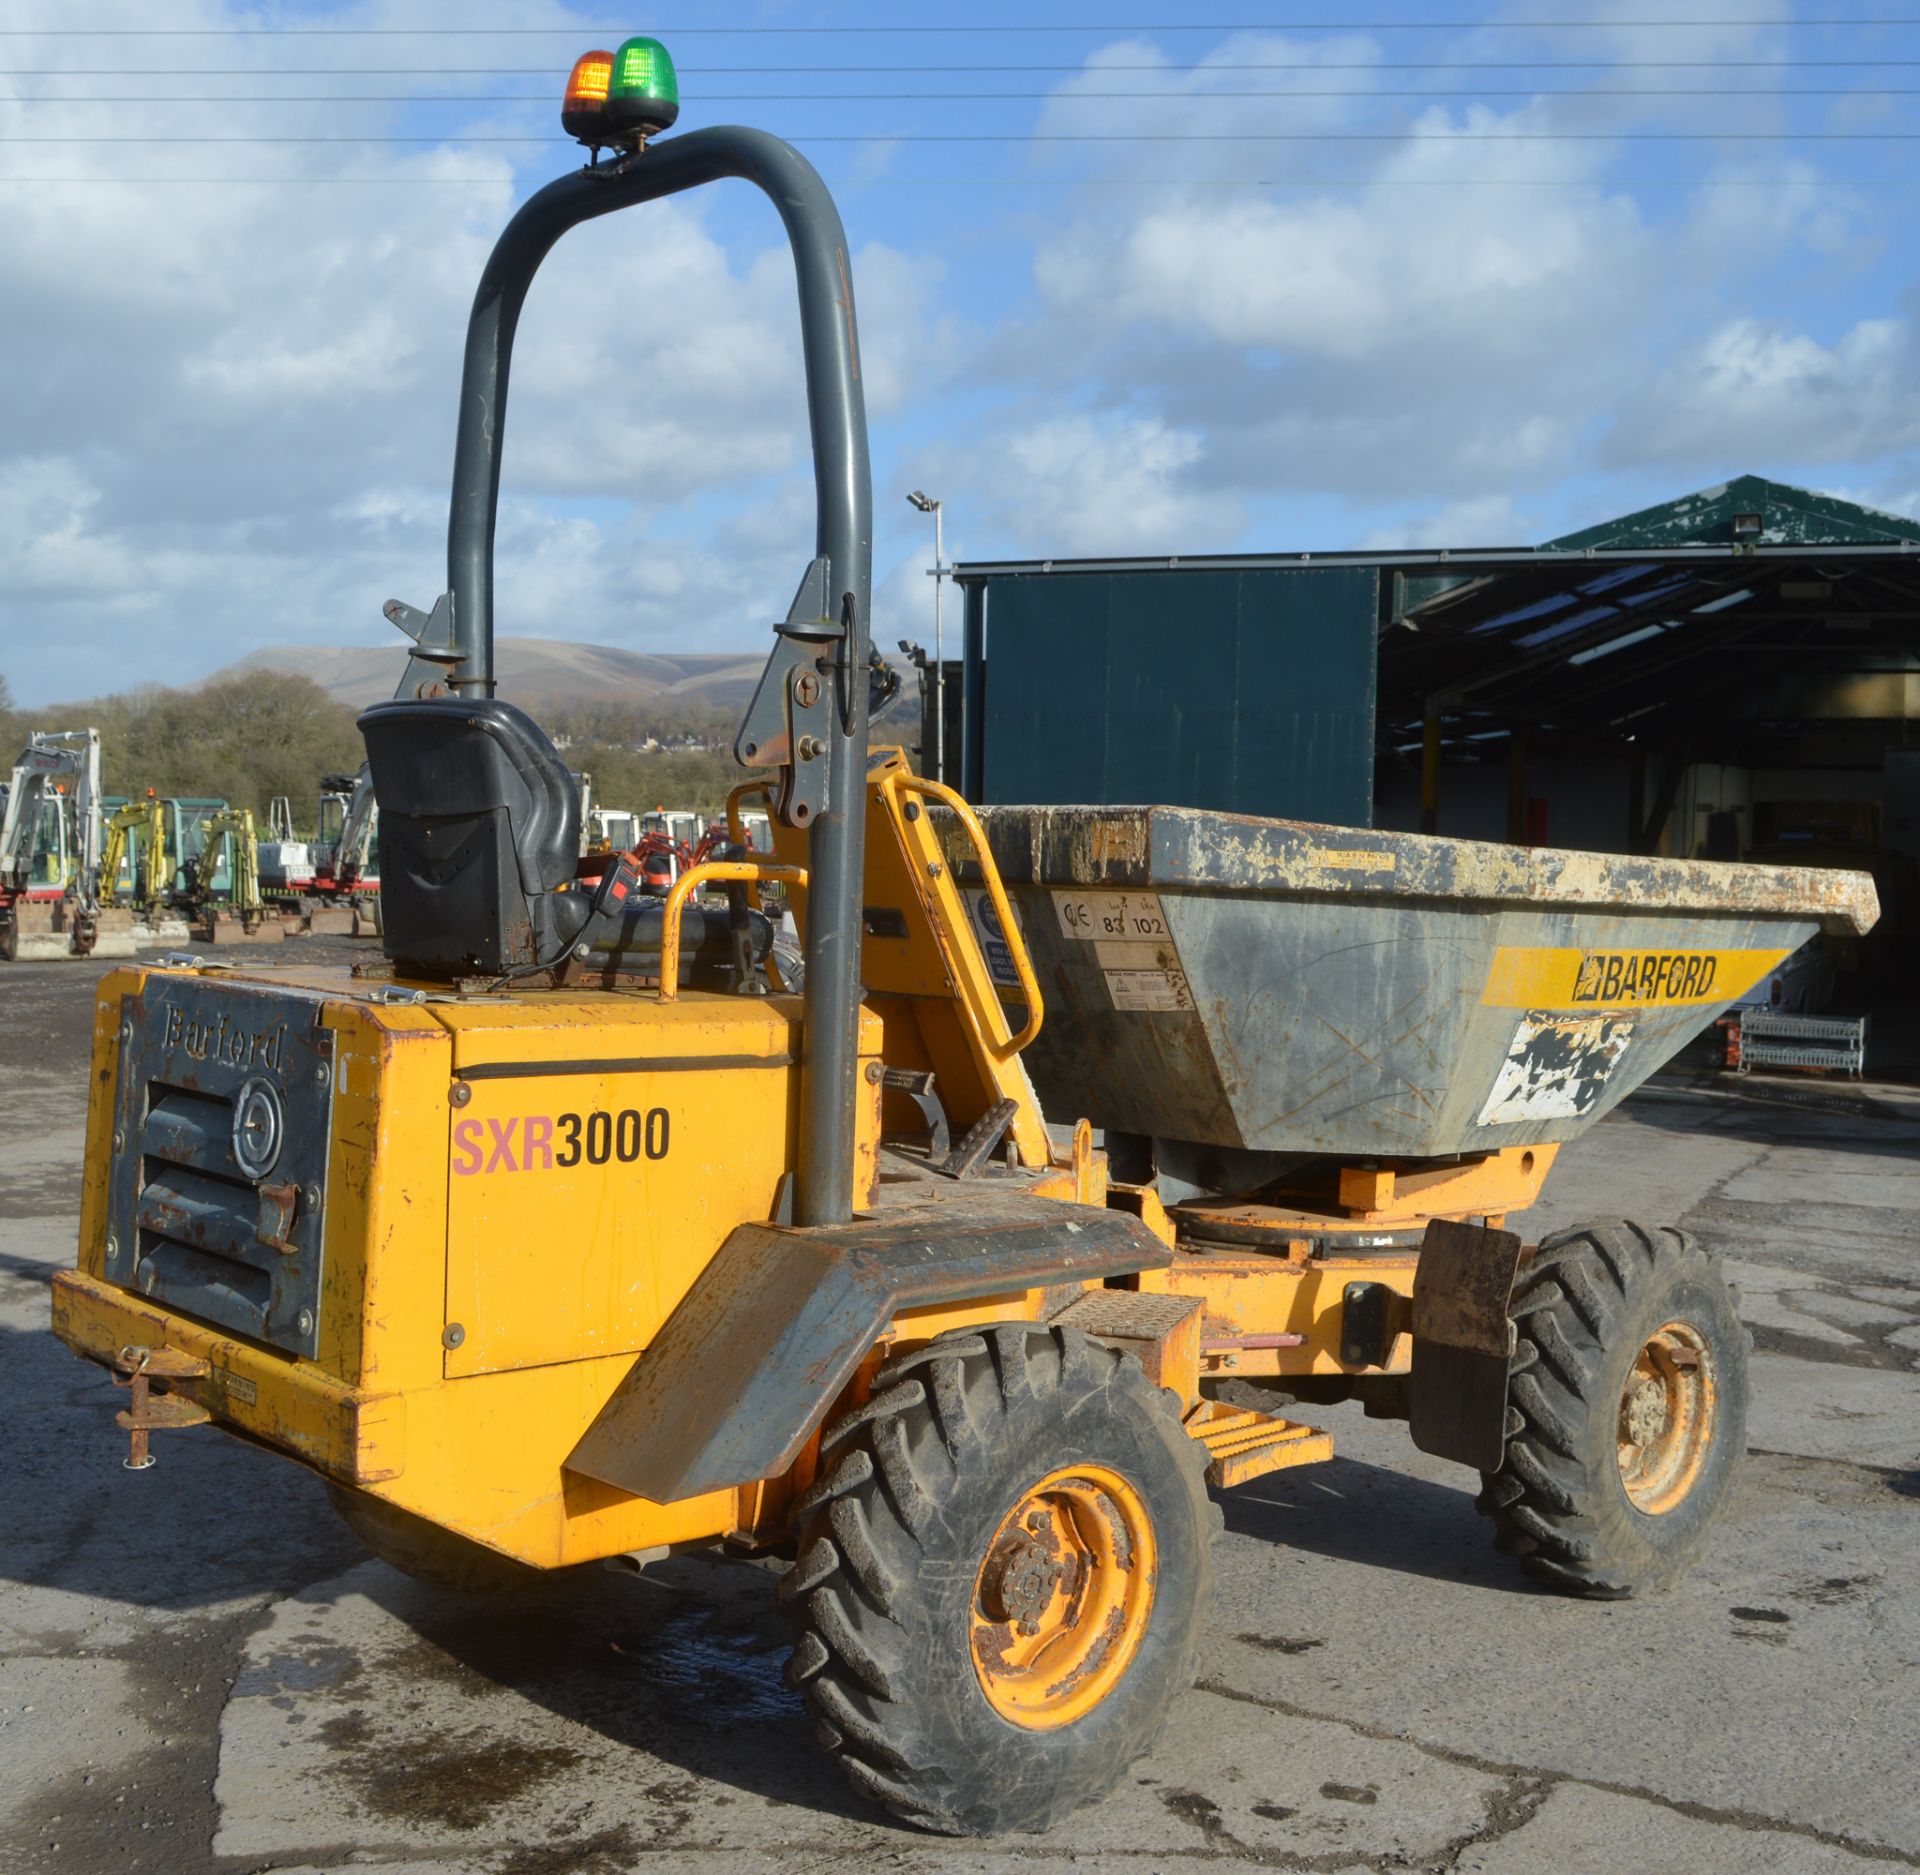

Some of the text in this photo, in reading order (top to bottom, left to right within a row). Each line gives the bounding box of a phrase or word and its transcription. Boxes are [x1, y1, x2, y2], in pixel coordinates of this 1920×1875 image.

[1103, 917, 1165, 935] 83 102
[1600, 955, 1717, 1001] BARFORD
[162, 1003, 288, 1074] Barford
[452, 1107, 670, 1176] SXR3000
